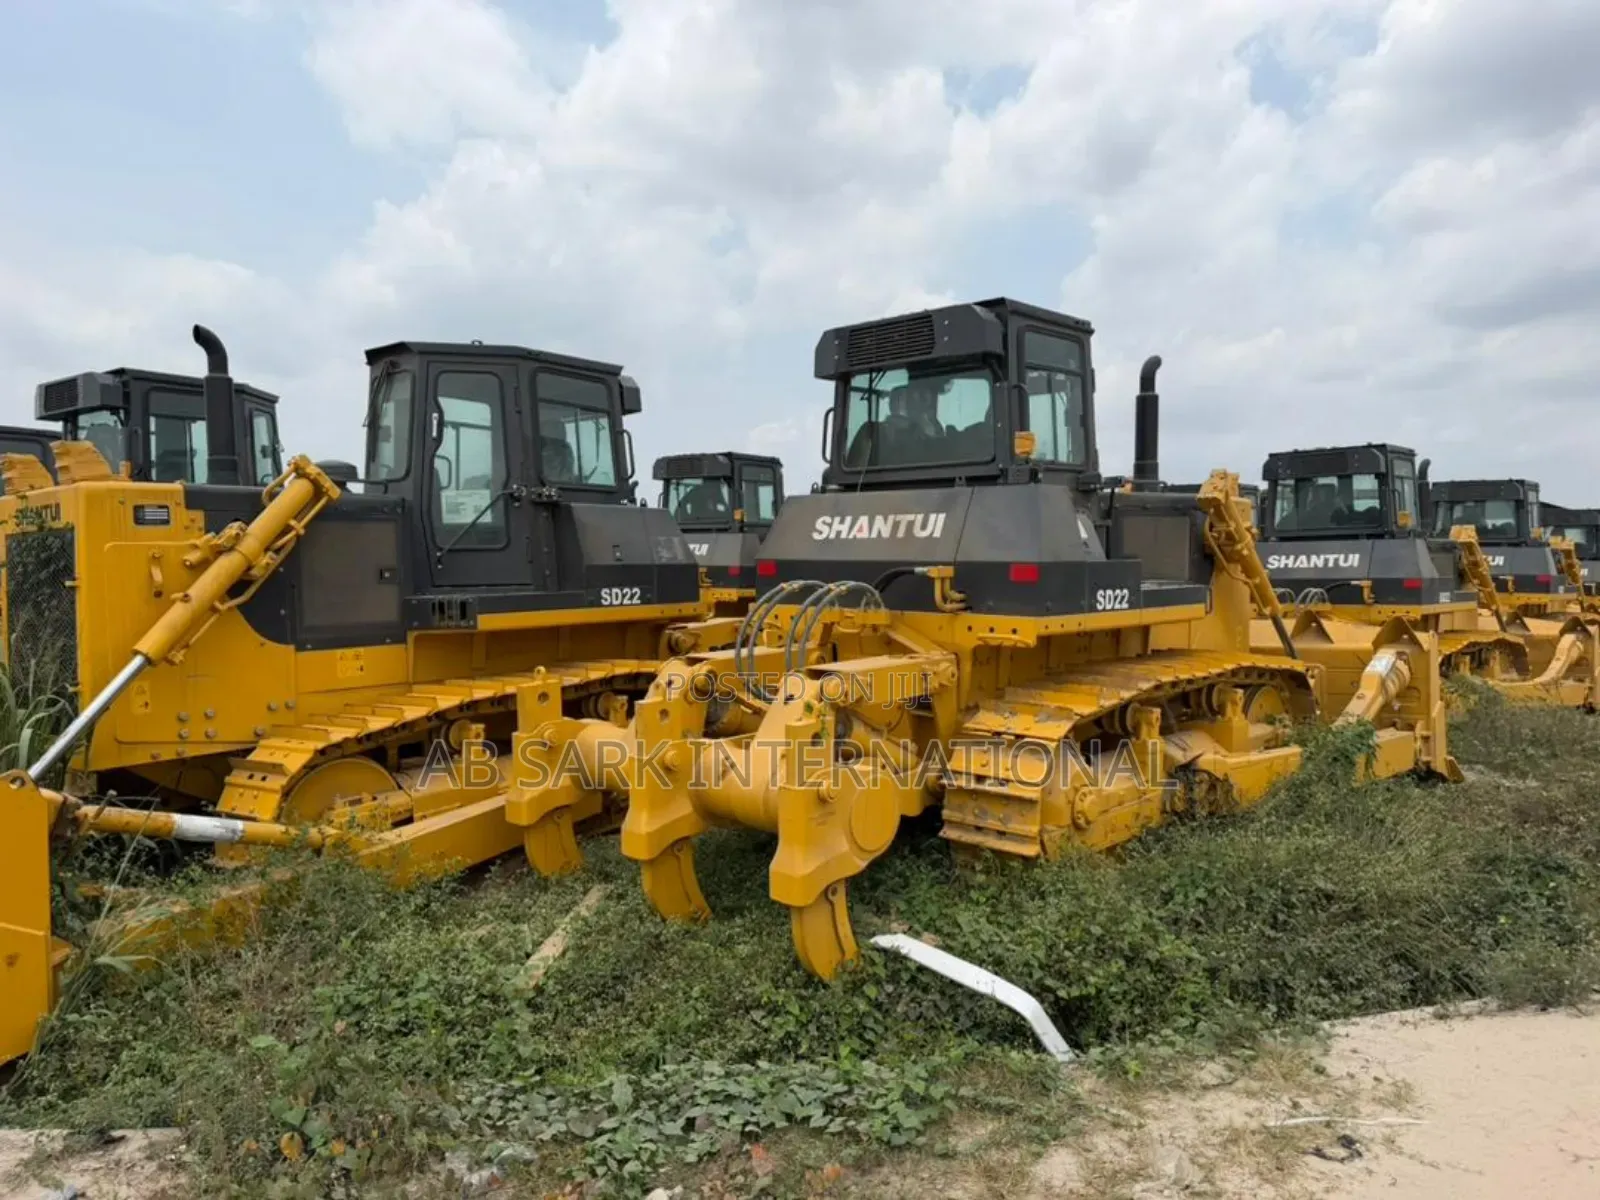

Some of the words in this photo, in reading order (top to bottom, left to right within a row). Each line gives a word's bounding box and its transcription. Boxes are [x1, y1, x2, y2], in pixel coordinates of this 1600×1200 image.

[812, 512, 946, 541] SHANTUI
[1265, 553, 1360, 570] SHANTUI
[600, 587, 642, 605] SD22
[1095, 588, 1130, 610] SD22
